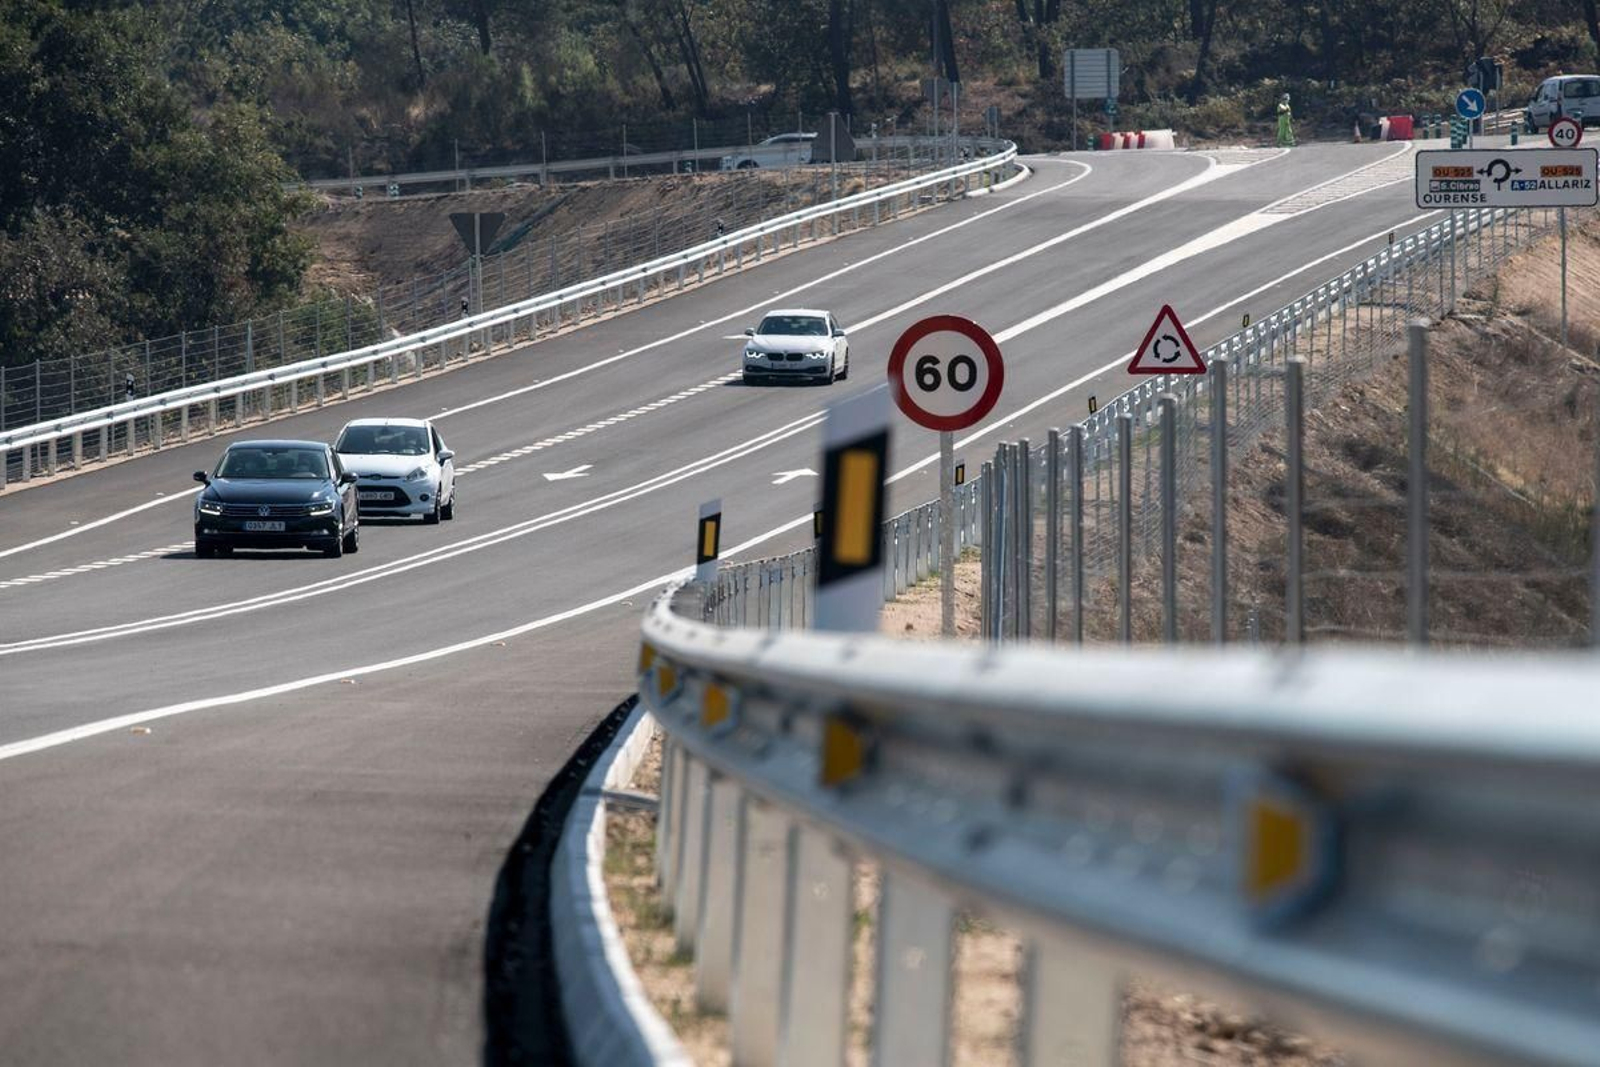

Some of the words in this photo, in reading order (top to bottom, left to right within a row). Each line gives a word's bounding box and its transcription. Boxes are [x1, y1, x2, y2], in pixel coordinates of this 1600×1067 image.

[1555, 128, 1575, 140] 40
[1539, 179, 1592, 190] ALLARIZ
[1423, 192, 1487, 204] OURENSE
[915, 354, 977, 392] 60
